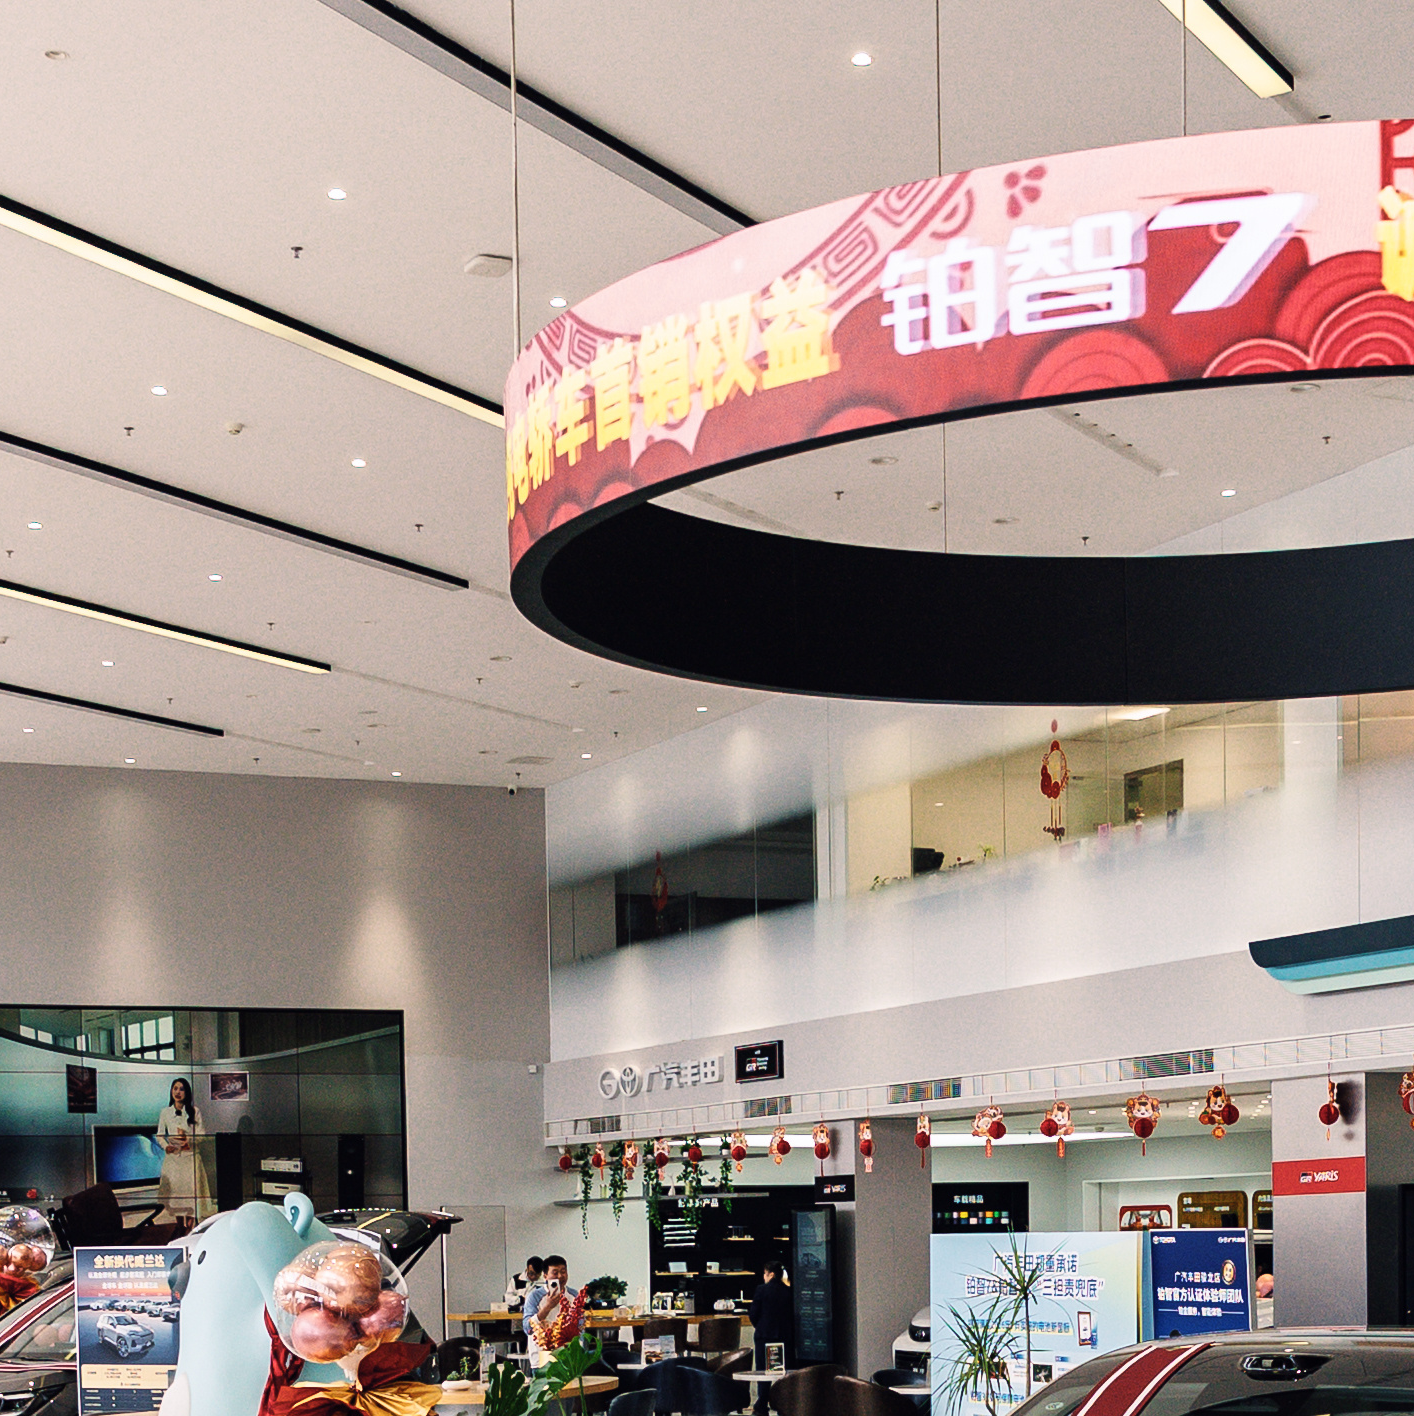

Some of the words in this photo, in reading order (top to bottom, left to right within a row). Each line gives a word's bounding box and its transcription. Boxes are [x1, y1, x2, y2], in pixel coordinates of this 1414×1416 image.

[881, 193, 1317, 355] 铂智7
[643, 1055, 724, 1093] 广汽丰田
[1314, 1169, 1339, 1183] YARIS
